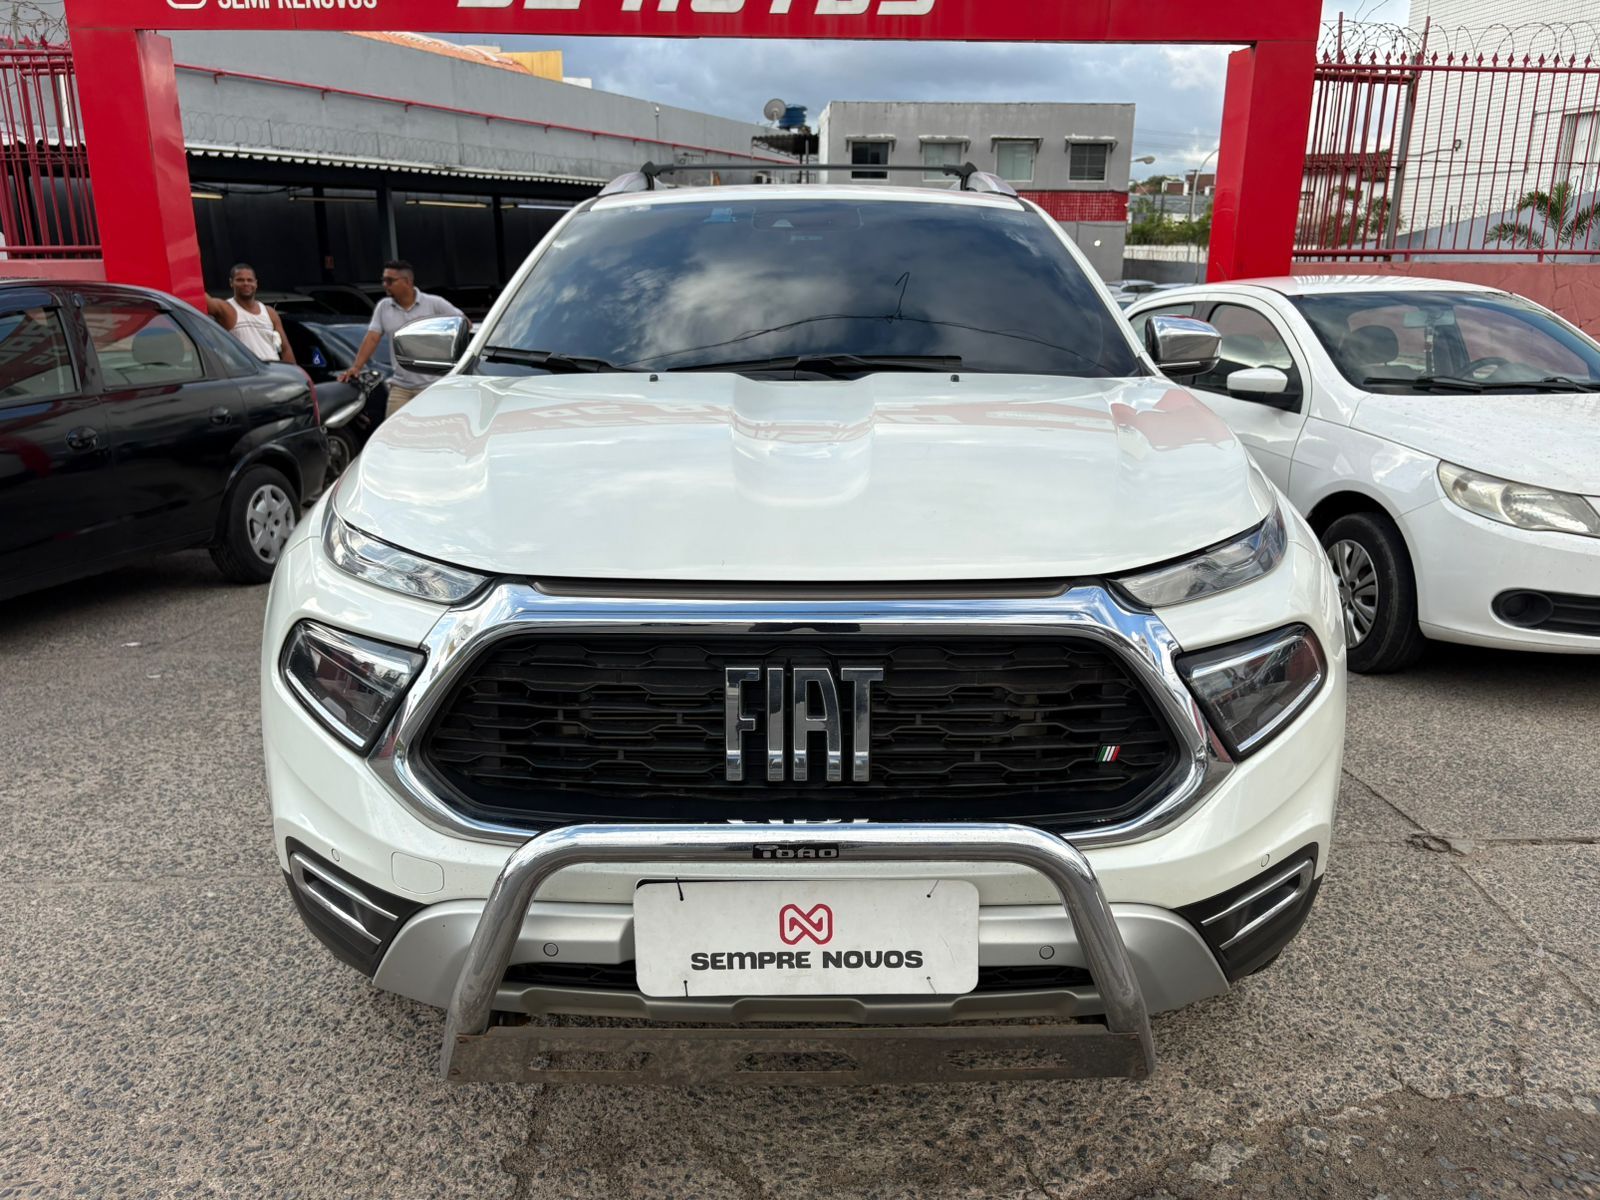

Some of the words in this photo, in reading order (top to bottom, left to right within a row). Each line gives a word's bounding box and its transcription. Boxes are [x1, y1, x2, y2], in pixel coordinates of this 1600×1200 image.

[725, 667, 884, 782] FIAT
[690, 951, 811, 971] SEMPRE
[822, 950, 924, 969] NOVOS
